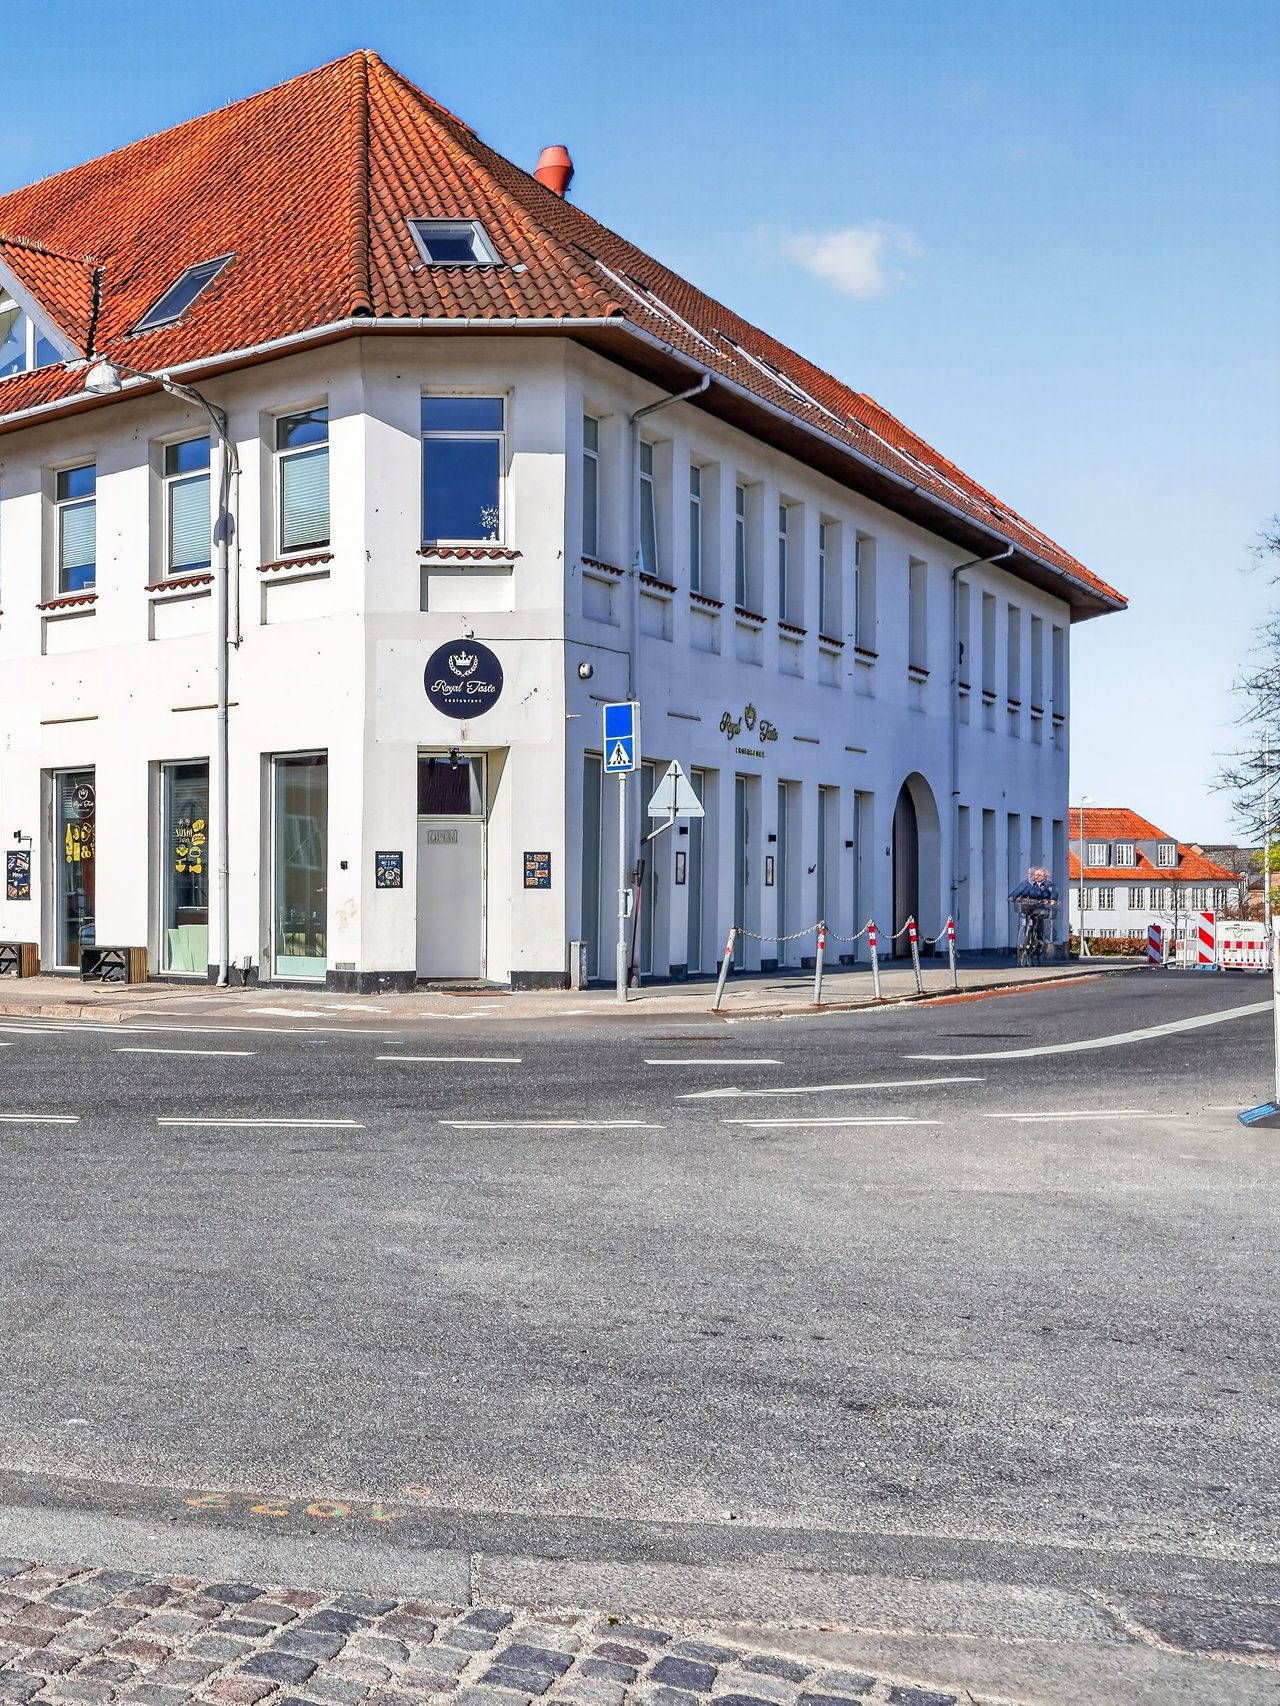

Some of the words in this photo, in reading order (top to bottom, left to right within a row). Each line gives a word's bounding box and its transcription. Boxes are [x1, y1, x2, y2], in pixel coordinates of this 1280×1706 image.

[430, 679, 464, 696] Royal
[466, 680, 496, 695] Taste
[719, 711, 742, 741] Royal
